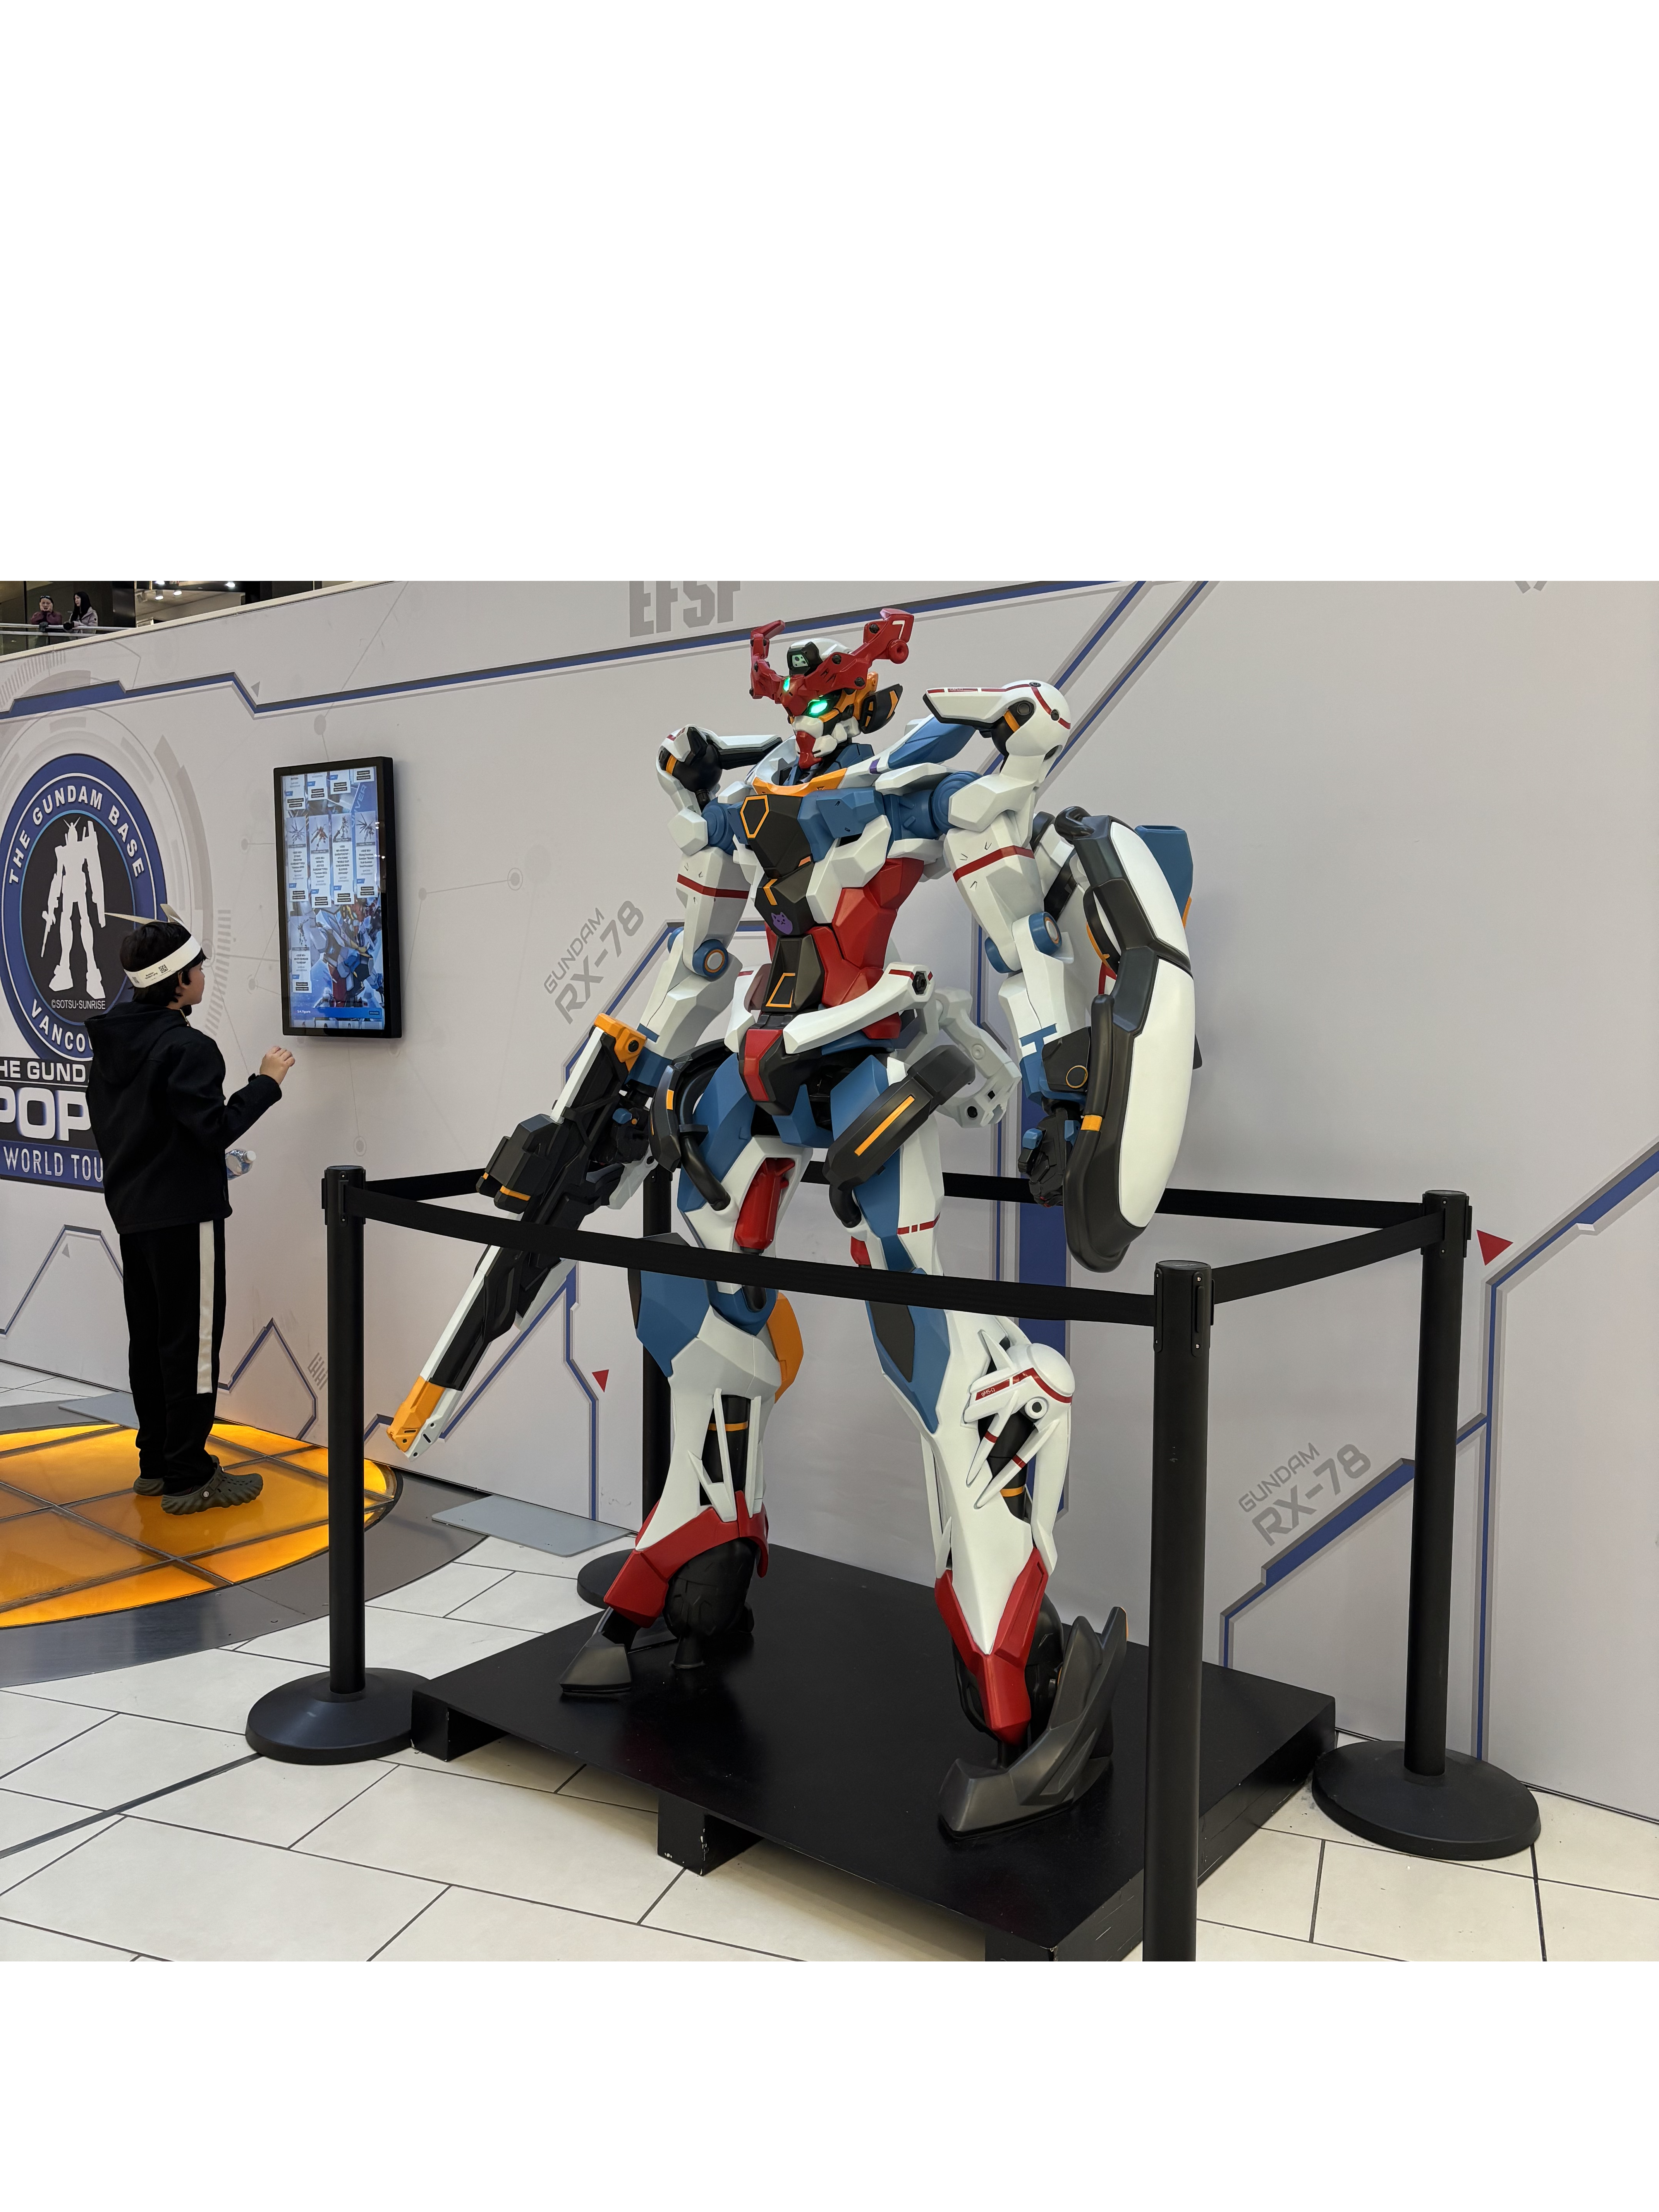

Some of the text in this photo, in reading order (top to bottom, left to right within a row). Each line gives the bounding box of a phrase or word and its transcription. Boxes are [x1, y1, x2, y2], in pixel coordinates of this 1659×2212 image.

[9, 785, 144, 884] THE GUNDAM BASE
[544, 907, 605, 994] GUNDAM
[555, 900, 644, 1024] RX-78
[31, 999, 93, 1052] VANCO
[27, 1061, 89, 1083] GUND
[3, 1146, 103, 1182] WORLD TOU
[1238, 1443, 1320, 1513] GUNDAM
[1252, 1444, 1371, 1546] RX-78
